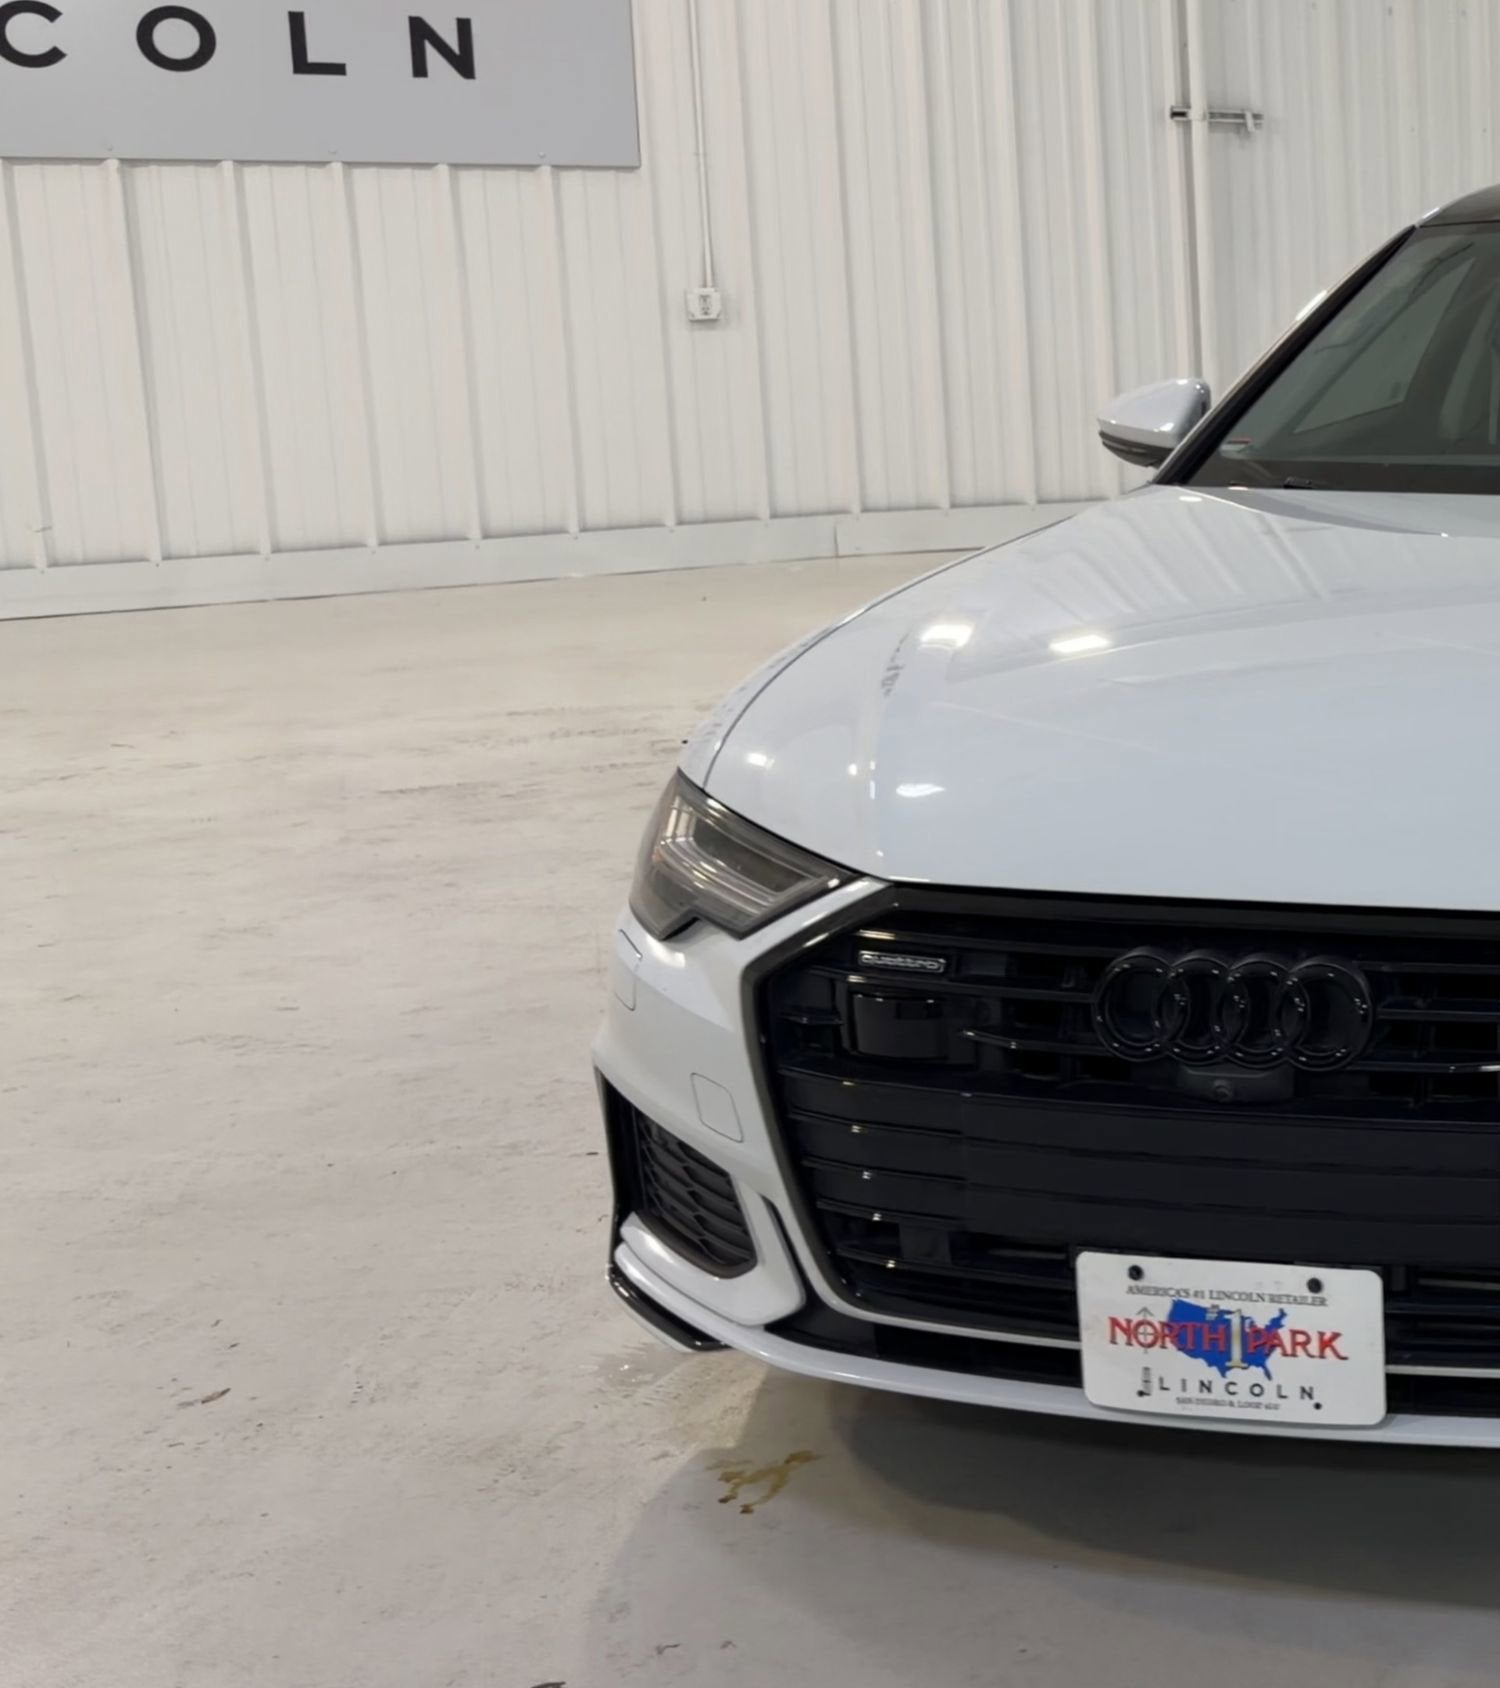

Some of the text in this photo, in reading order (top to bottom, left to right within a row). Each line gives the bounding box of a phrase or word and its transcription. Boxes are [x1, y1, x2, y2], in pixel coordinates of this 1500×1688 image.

[0, 0, 476, 80] COLN
[1209, 1290, 1265, 1303] LINCOLN
[1108, 1316, 1349, 1361] NORTH PARK
[1158, 1376, 1314, 1400] LINCOLN
